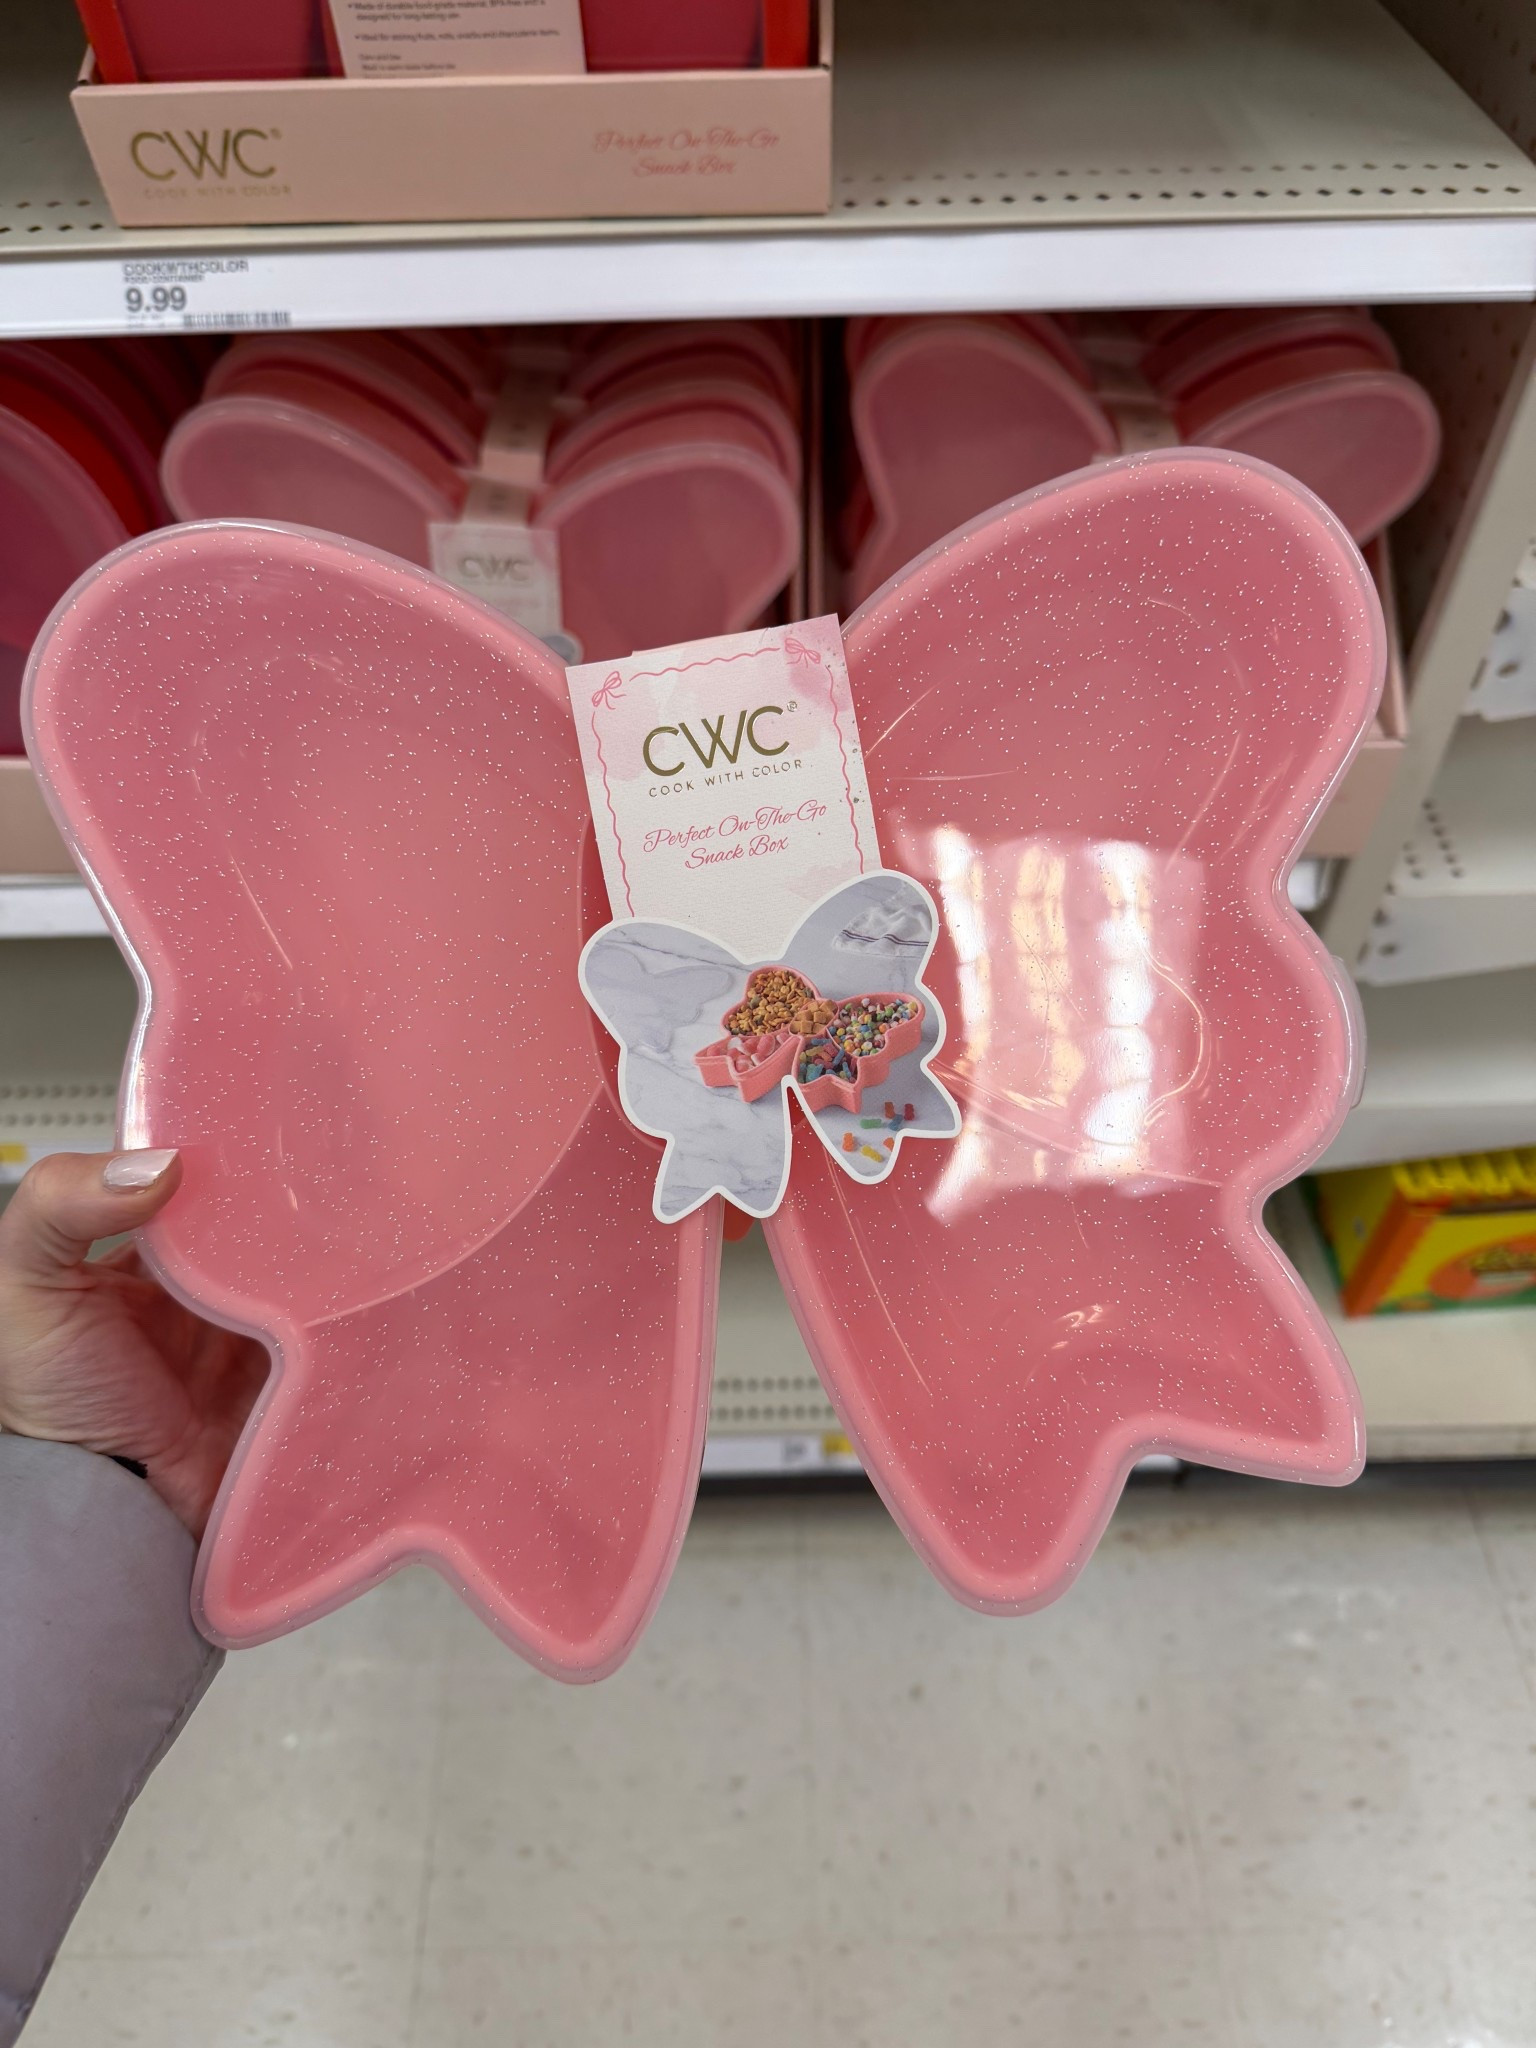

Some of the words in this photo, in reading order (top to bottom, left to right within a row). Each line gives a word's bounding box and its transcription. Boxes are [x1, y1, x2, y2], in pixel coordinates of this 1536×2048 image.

[125, 286, 188, 313] 9.99
[648, 779, 695, 798] COOK
[704, 770, 744, 787] WITH
[752, 759, 803, 778] COLOR
[643, 825, 716, 853] Perfect
[718, 799, 828, 837] On-The-Go
[684, 843, 745, 869] Snack
[748, 834, 789, 856] Box
